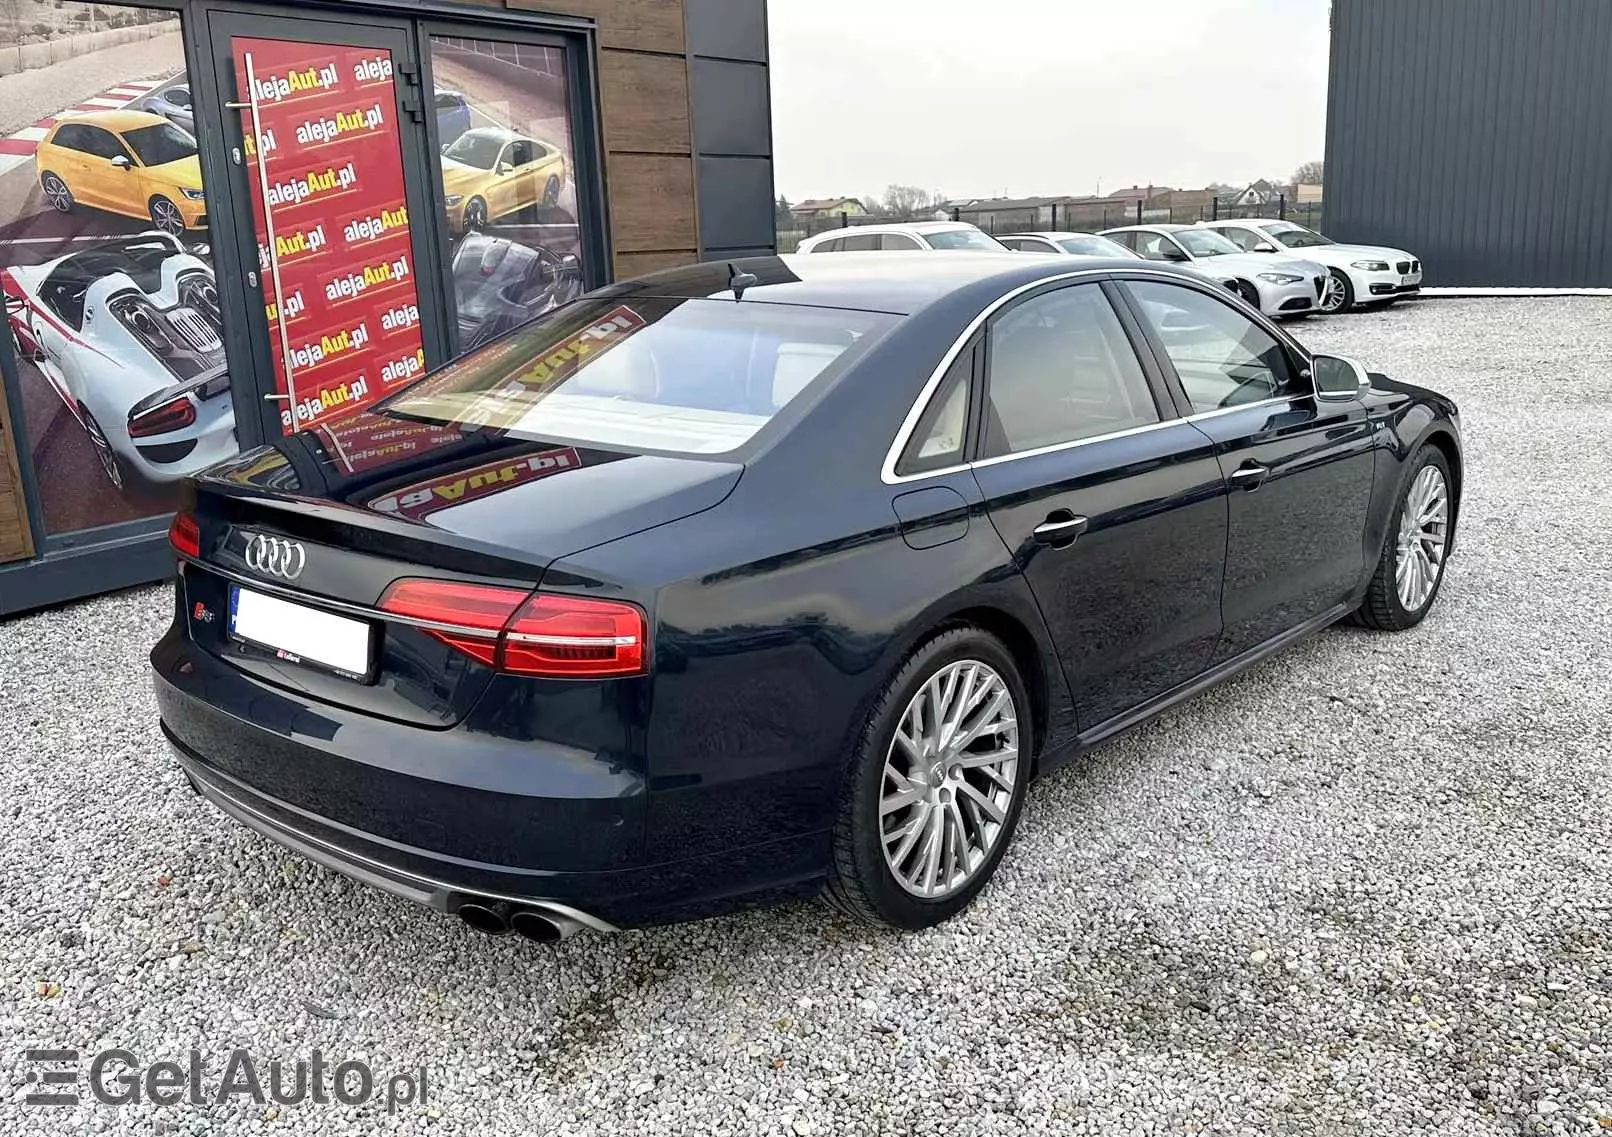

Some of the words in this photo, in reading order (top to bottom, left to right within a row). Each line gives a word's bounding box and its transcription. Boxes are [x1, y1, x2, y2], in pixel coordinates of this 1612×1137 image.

[353, 56, 393, 82] aleja
[296, 103, 384, 144] alejaAut.pl
[268, 162, 357, 205] alejaAut.pl
[325, 255, 410, 301] alejaAut.pl
[381, 305, 419, 330] aleja
[281, 323, 369, 370] lejaAut.pl
[281, 375, 369, 426] aejaAut.pl
